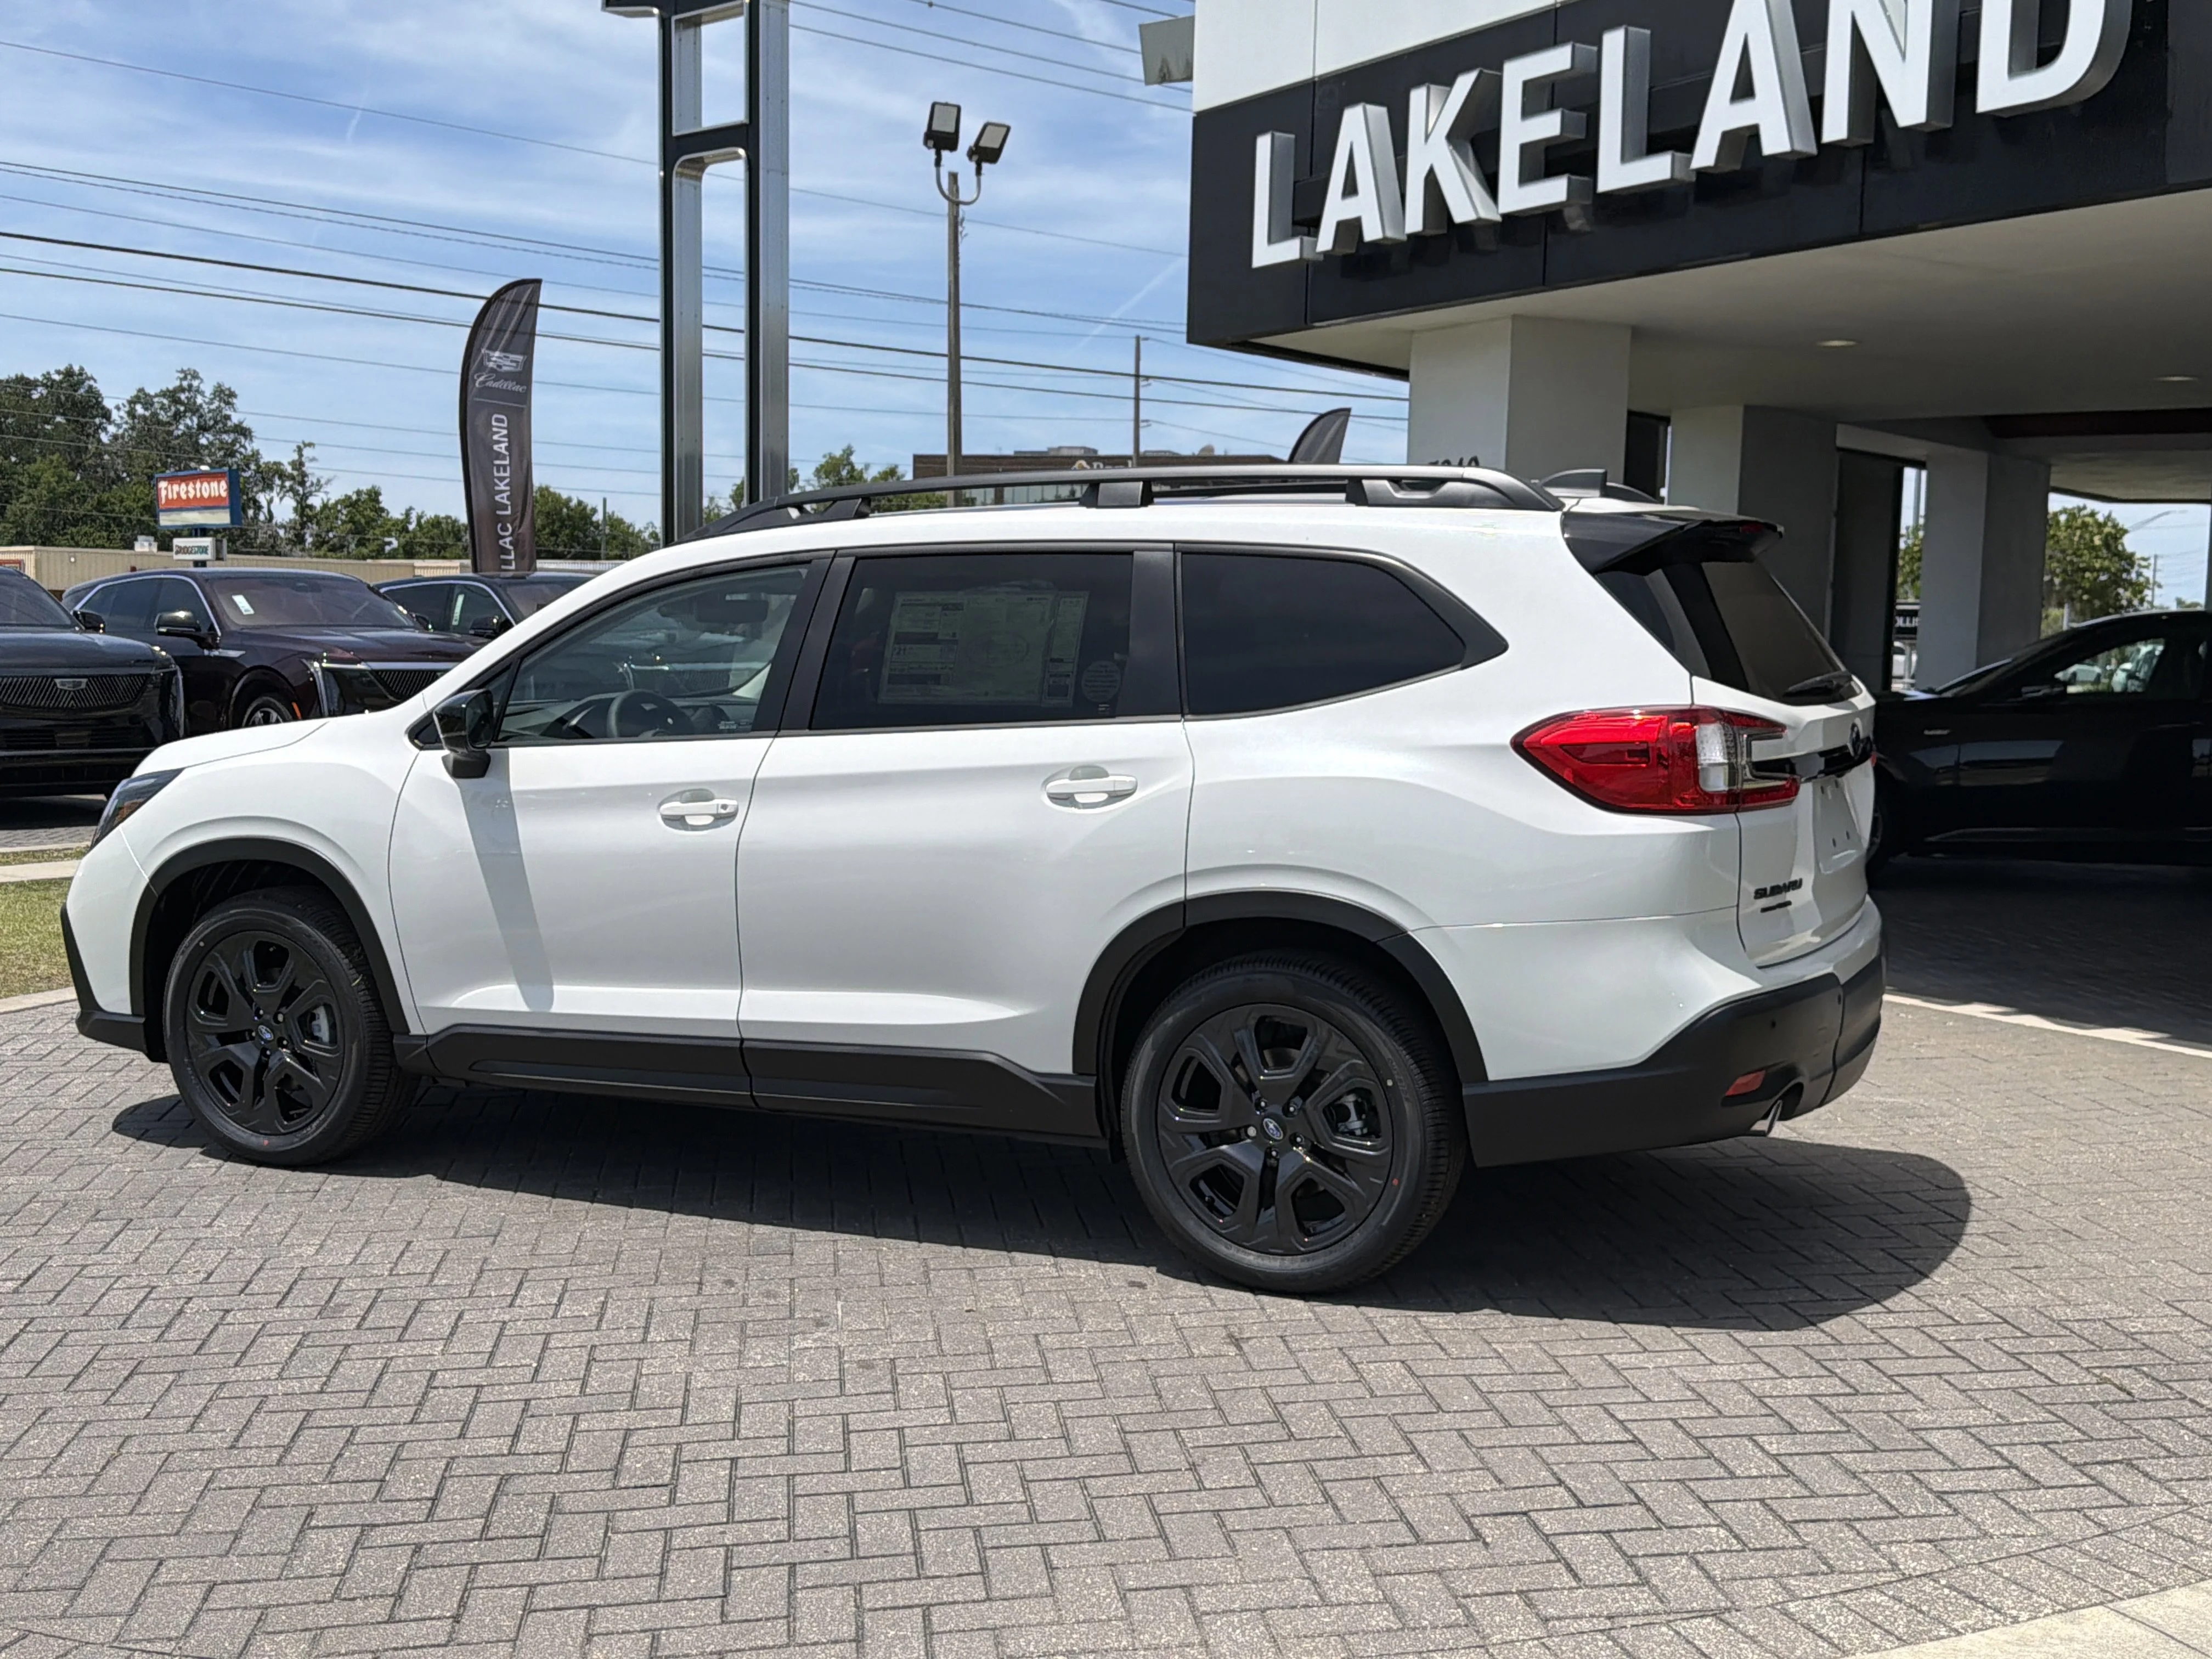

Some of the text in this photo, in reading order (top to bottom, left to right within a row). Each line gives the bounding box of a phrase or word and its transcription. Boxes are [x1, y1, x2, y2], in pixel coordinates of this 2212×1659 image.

[474, 373, 527, 393] Cadillac
[492, 413, 511, 515] LAKELAND
[158, 478, 228, 505] Firestone
[1753, 878, 1803, 900] SUBARU
